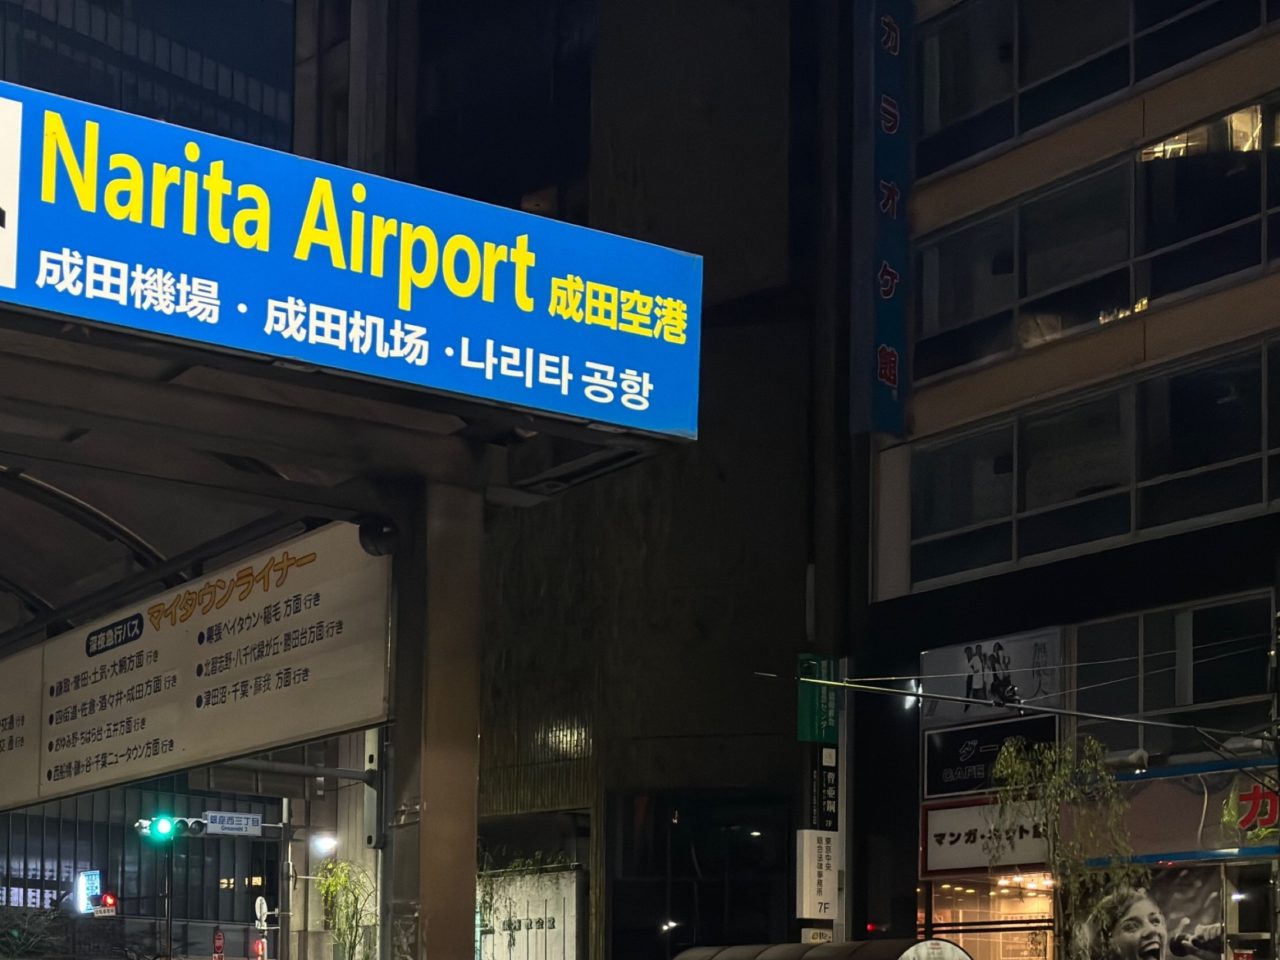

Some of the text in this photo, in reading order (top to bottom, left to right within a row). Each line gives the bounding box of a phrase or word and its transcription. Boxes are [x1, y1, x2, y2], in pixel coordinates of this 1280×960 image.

[41, 110, 536, 312] Narita Airport
[36, 247, 429, 365] 成田機場 成田机场
[548, 274, 688, 345] 成田空港
[581, 361, 654, 411] 공항
[148, 552, 317, 631] マイタウンライナー
[818, 902, 831, 914] 7F
